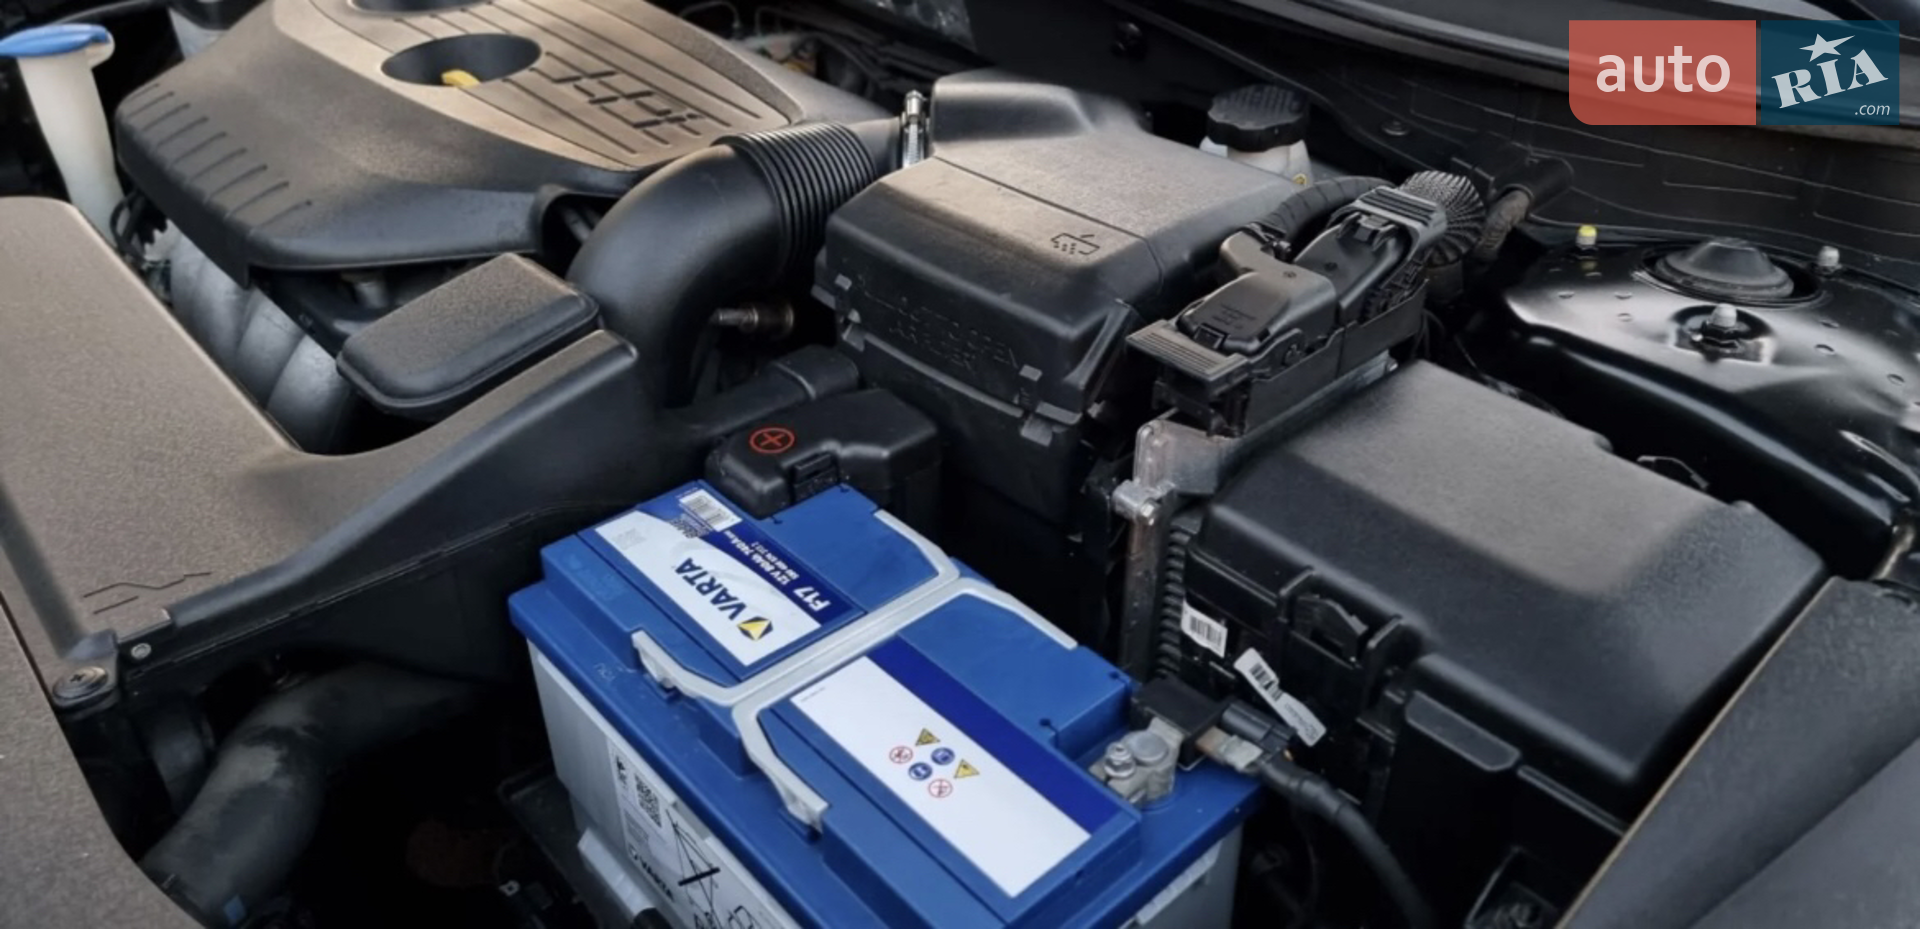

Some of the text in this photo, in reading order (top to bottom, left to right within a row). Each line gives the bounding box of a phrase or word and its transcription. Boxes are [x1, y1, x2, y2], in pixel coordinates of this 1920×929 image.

[675, 557, 748, 620] VARTA
[770, 571, 791, 586] 12V
[794, 586, 831, 612] F17
